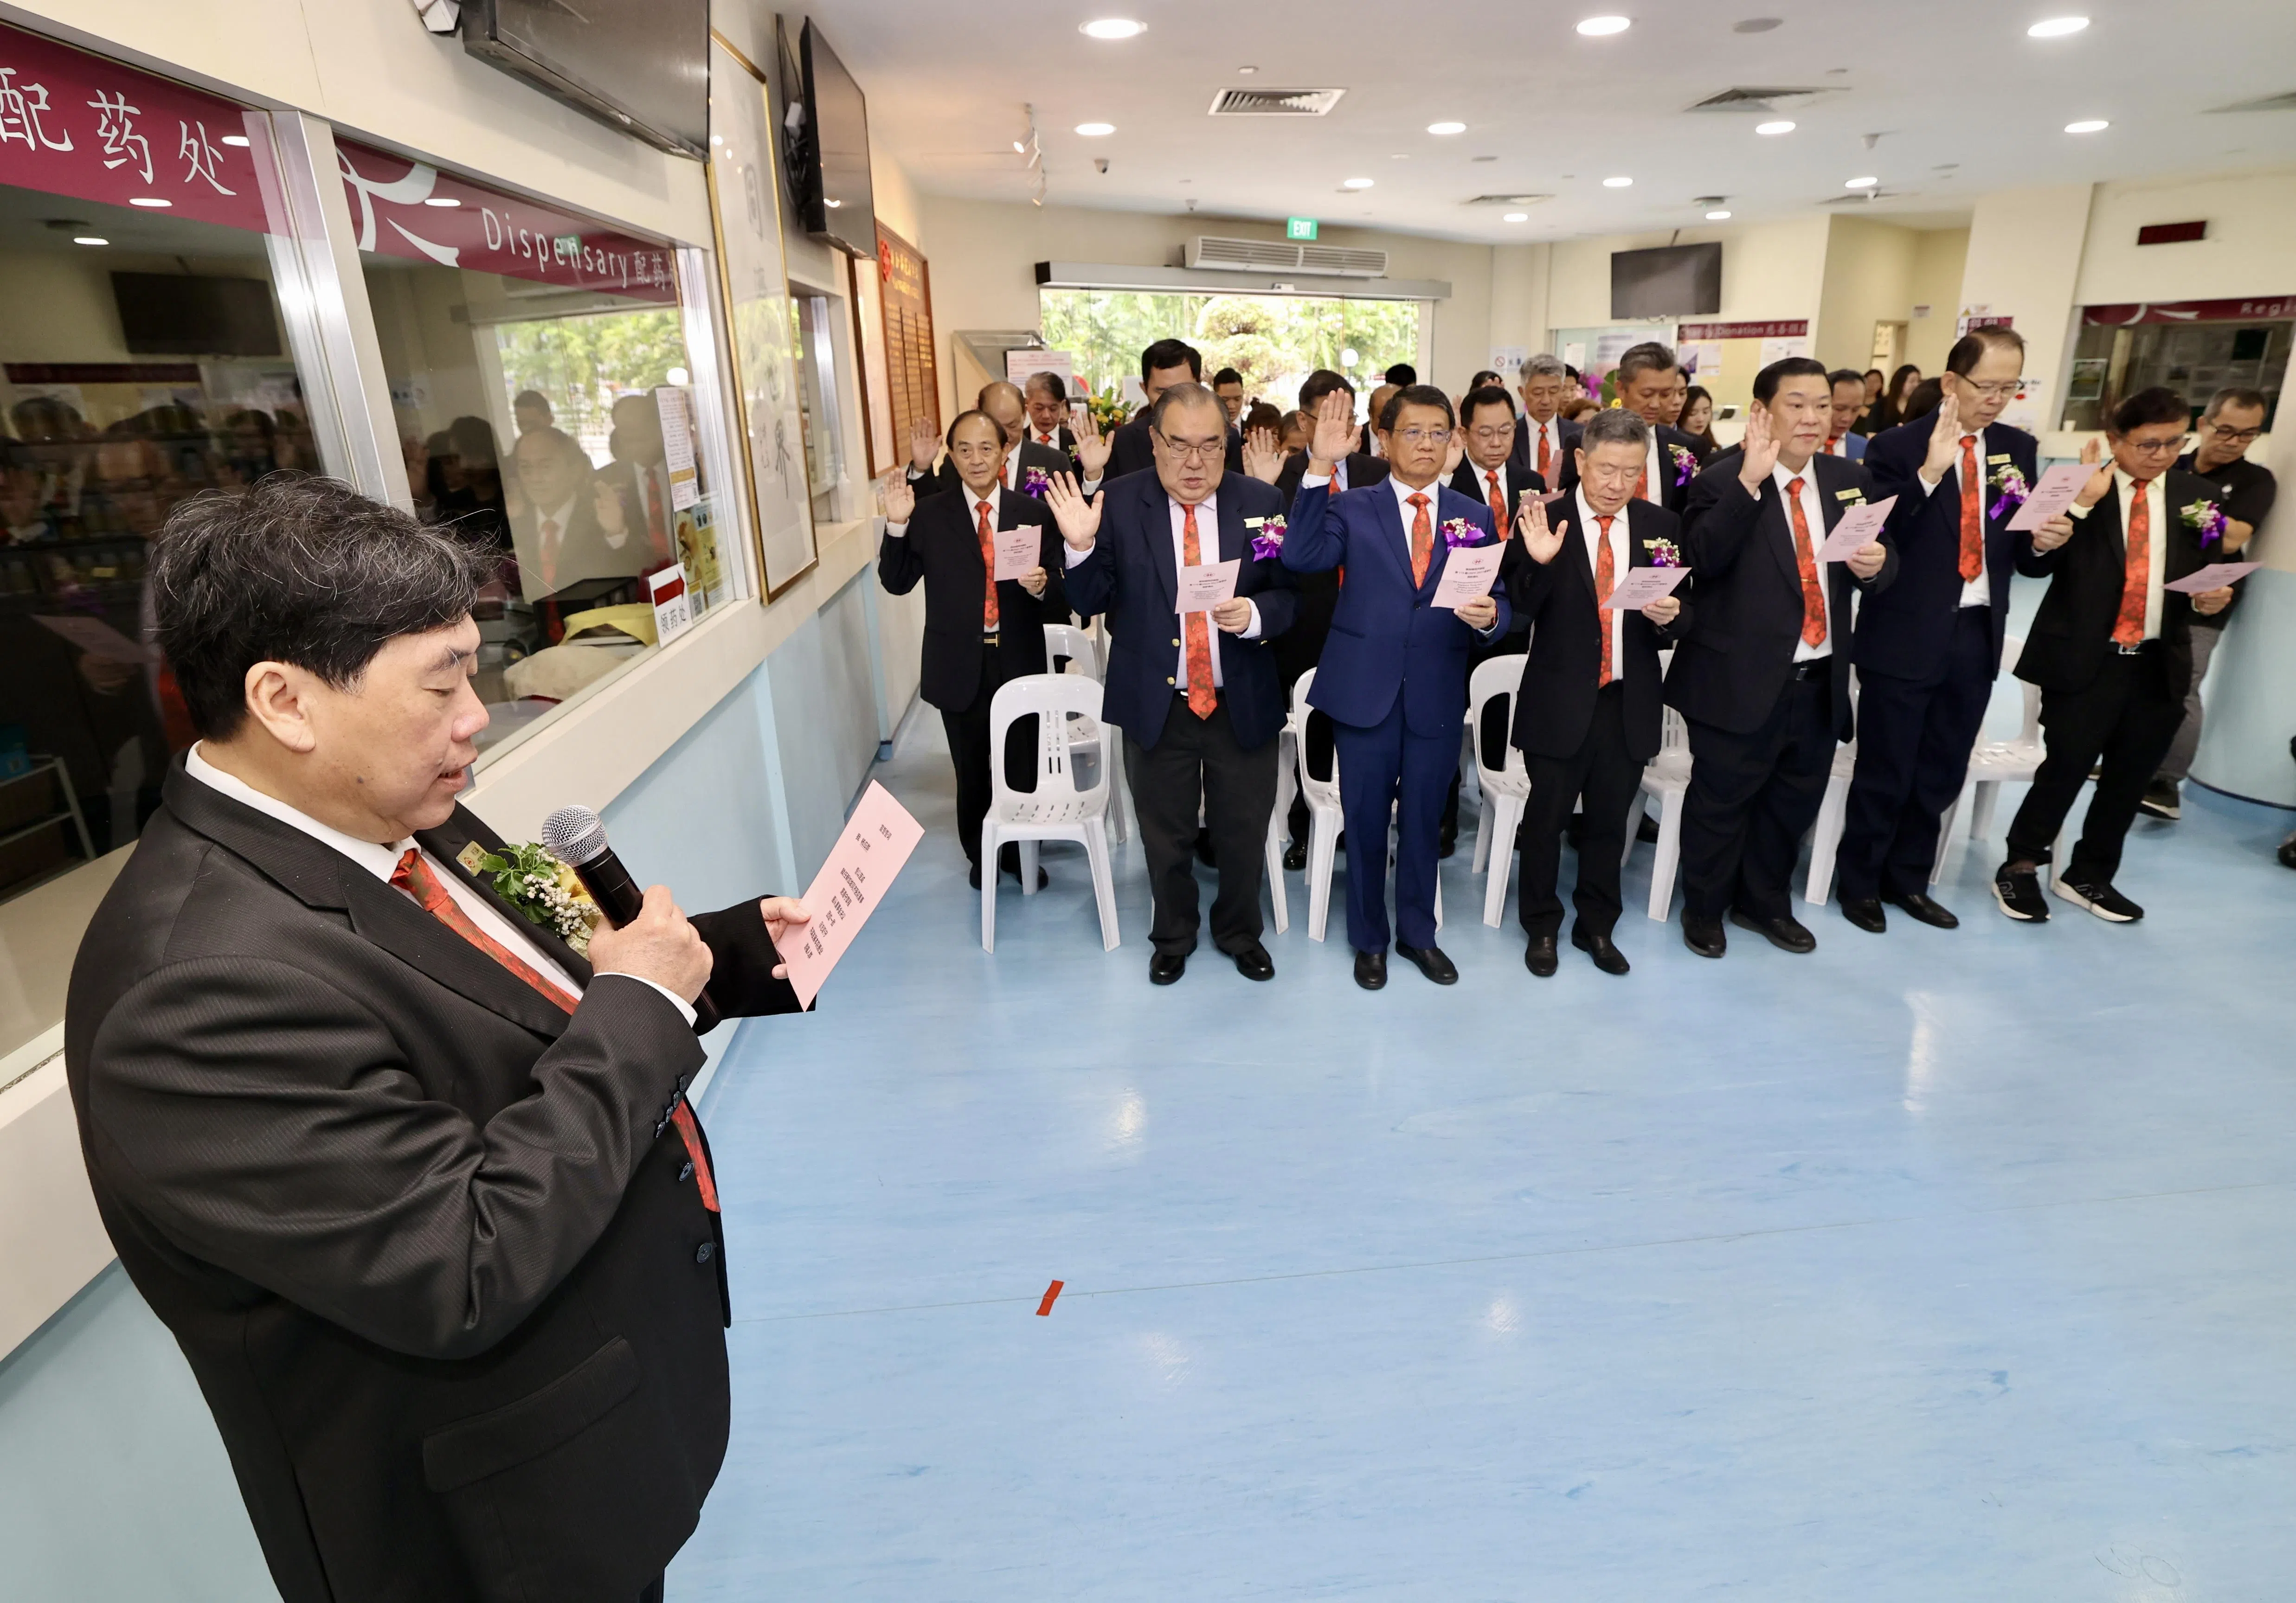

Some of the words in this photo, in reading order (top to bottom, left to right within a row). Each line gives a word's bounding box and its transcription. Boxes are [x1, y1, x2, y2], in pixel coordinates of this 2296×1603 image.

[0, 68, 237, 195] 配药处
[1293, 220, 1312, 237] EXIT
[482, 207, 628, 289] Dispensary
[2240, 299, 2296, 317] Regi
[661, 604, 687, 634] 领药处
